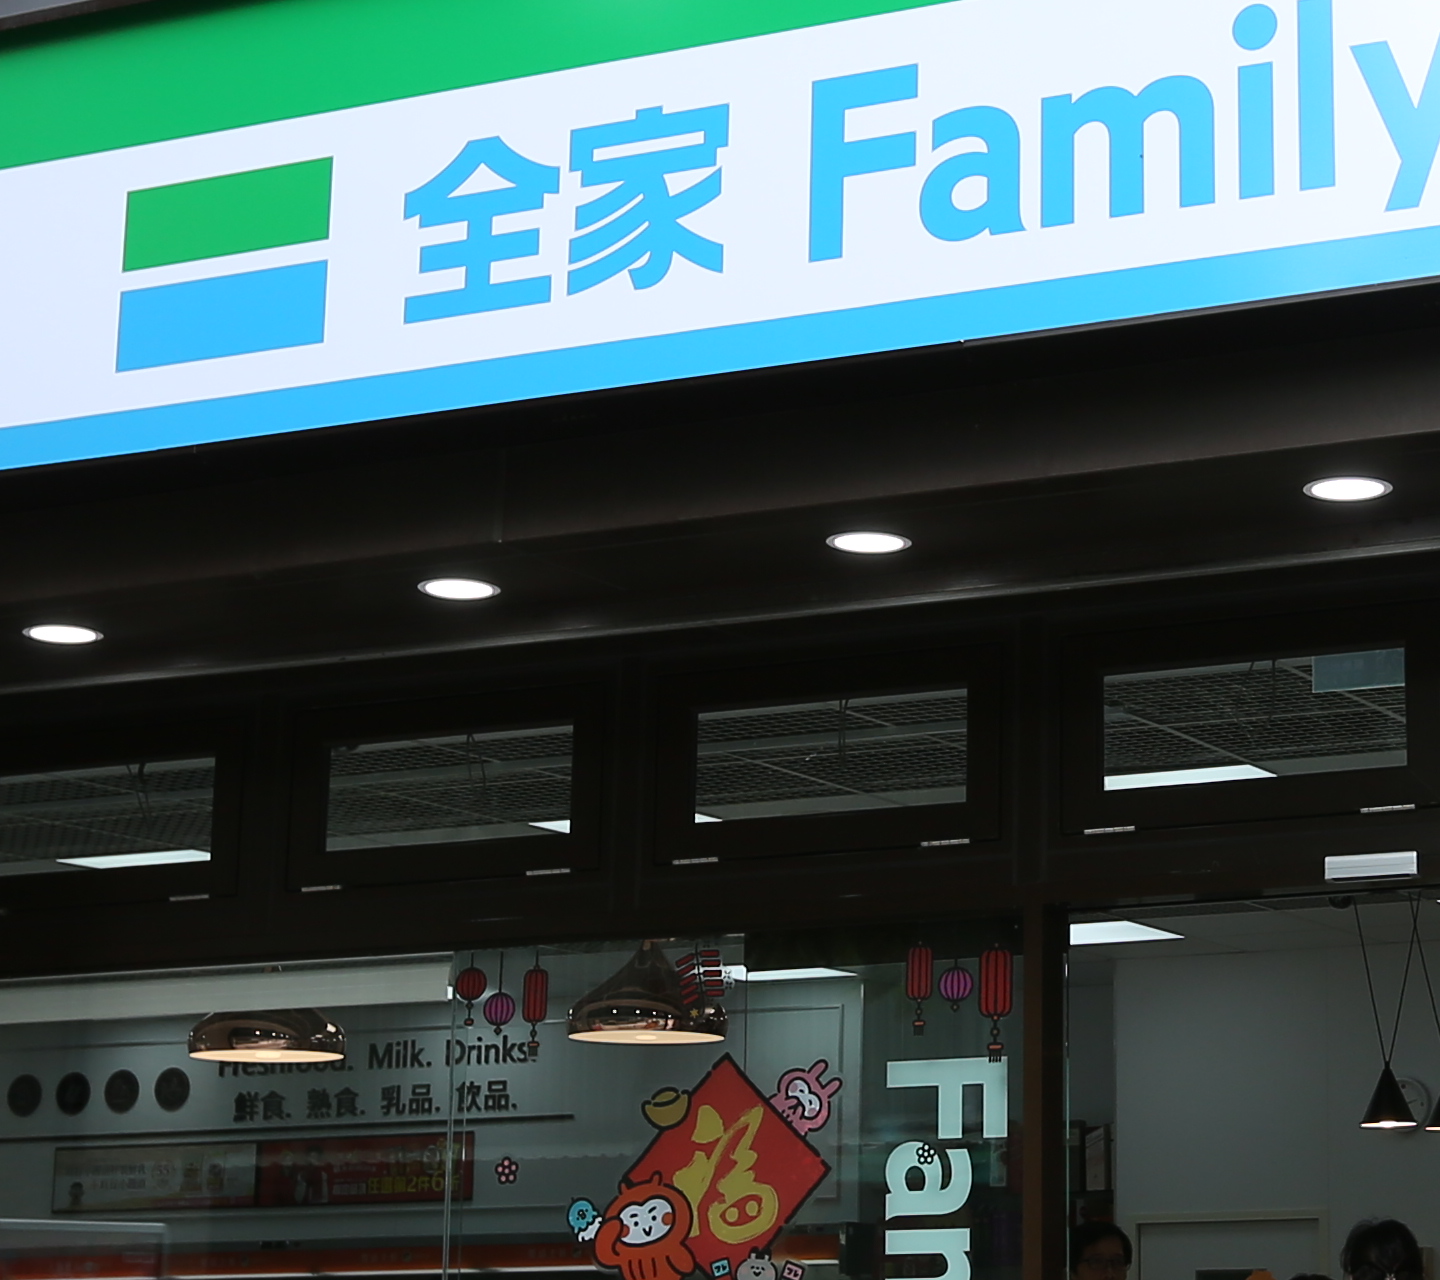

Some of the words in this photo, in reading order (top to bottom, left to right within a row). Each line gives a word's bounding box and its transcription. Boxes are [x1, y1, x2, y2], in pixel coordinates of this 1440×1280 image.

[403, 104, 733, 324] 全家
[367, 1041, 431, 1070] Milk.
[673, 1105, 778, 1244] 福
